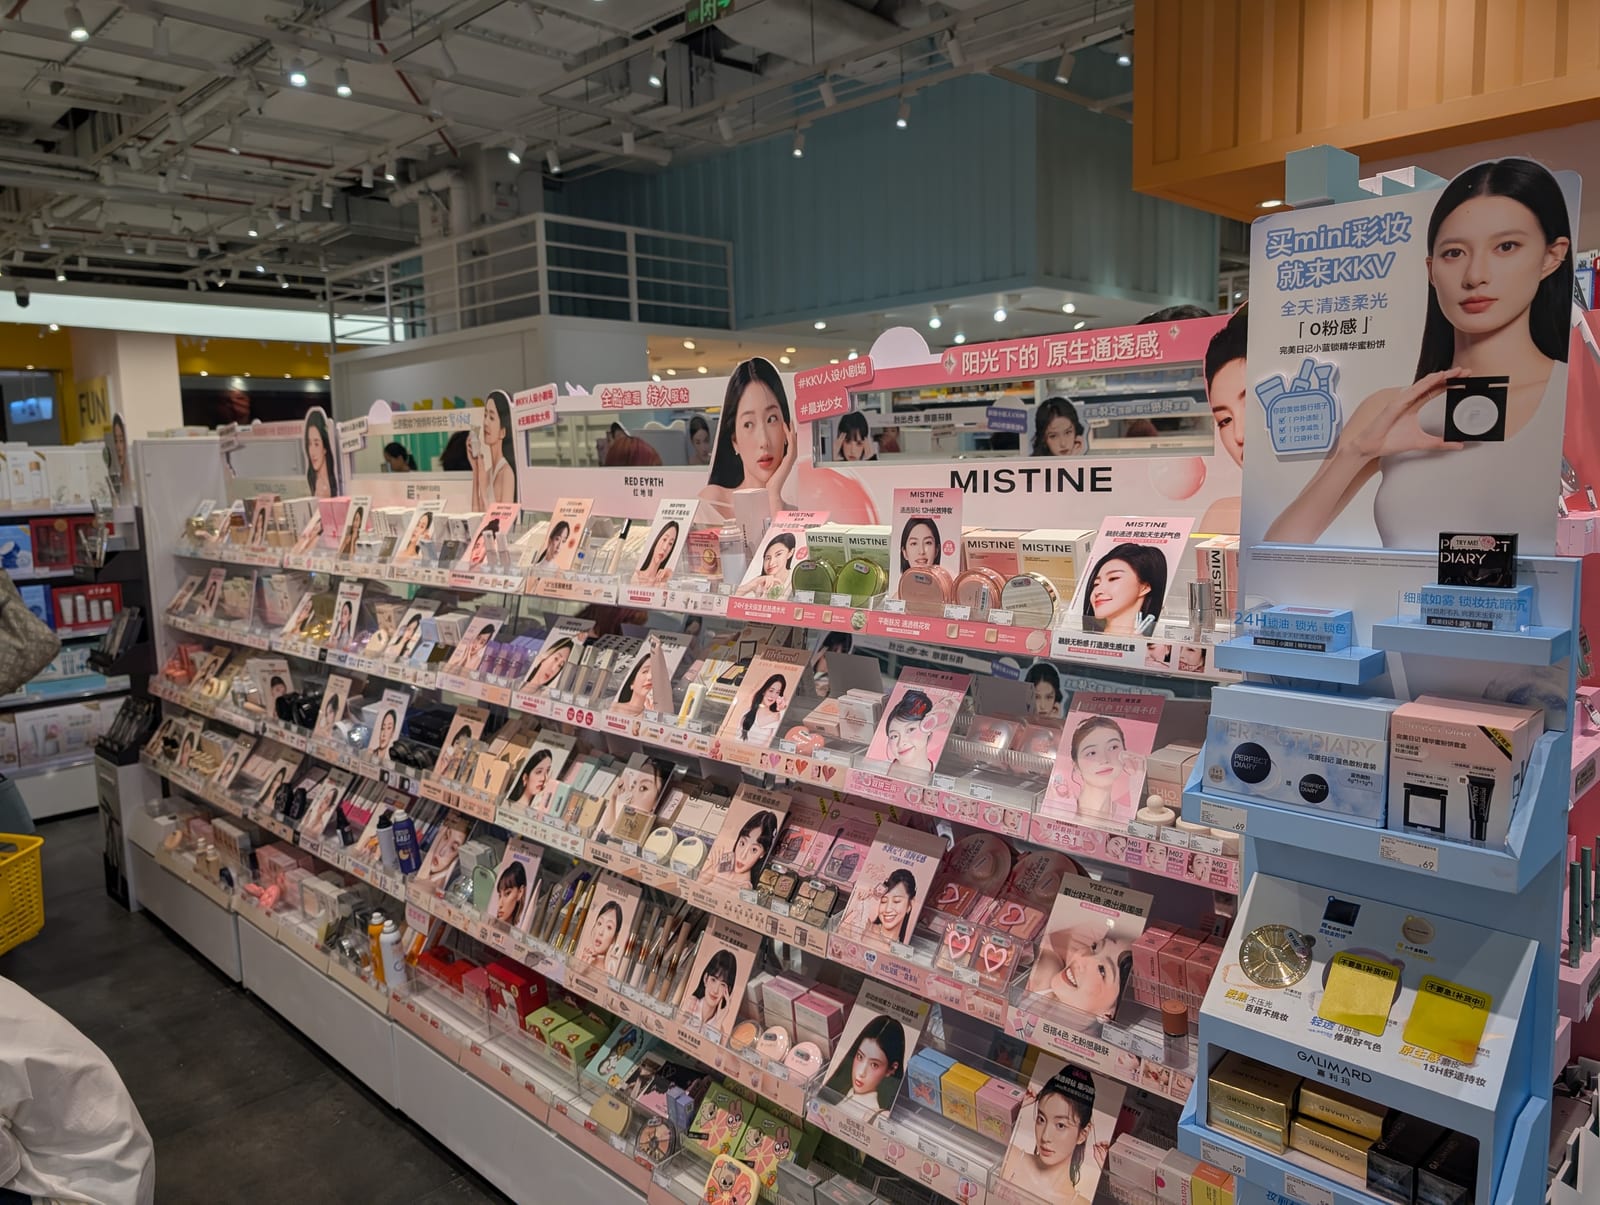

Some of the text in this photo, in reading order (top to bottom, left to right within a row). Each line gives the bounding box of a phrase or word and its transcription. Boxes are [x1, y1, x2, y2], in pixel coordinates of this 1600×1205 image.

[1266, 211, 1412, 259] 买mini彩妆
[1277, 252, 1396, 291] 就来KKV
[1281, 292, 1388, 317] 全天清透柔光
[798, 363, 868, 390] #KKV人设小剧场
[799, 396, 843, 416] #晨光少女
[624, 476, 639, 486] RED
[949, 466, 1113, 494] MISTINE
[808, 535, 843, 544] MISTINE
[849, 537, 888, 546] MISTINE
[967, 540, 1015, 550] MISTINE
[1022, 543, 1072, 553] MISTINE
[1440, 552, 1487, 565] DIARY
[1308, 731, 1377, 759] DIARY
[1233, 753, 1269, 766] PERFECT
[1233, 761, 1257, 771] DIARY
[1308, 753, 1335, 765] 完美日记
[1300, 781, 1327, 791] PERFECT
[1300, 786, 1319, 795] DIARY
[1054, 832, 1078, 846] 3合1
[1128, 840, 1141, 848] M01
[1168, 849, 1184, 858] M02
[1212, 860, 1228, 869] M03
[1249, 996, 1273, 1009] 不压光
[1244, 1004, 1289, 1022] 百搭不挑妆
[1042, 1023, 1070, 1041] 百搭4色
[1334, 1033, 1382, 1053] 修黄好气色
[1296, 1050, 1373, 1084] GALIMARD
[1423, 1063, 1487, 1088] 15H舒适持妆
[1226, 1094, 1266, 1112] GALIMARD
[1318, 1105, 1362, 1124] GALIMARD
[1224, 1118, 1263, 1137] GALIMARD
[1308, 1138, 1351, 1160] GALIMARD
